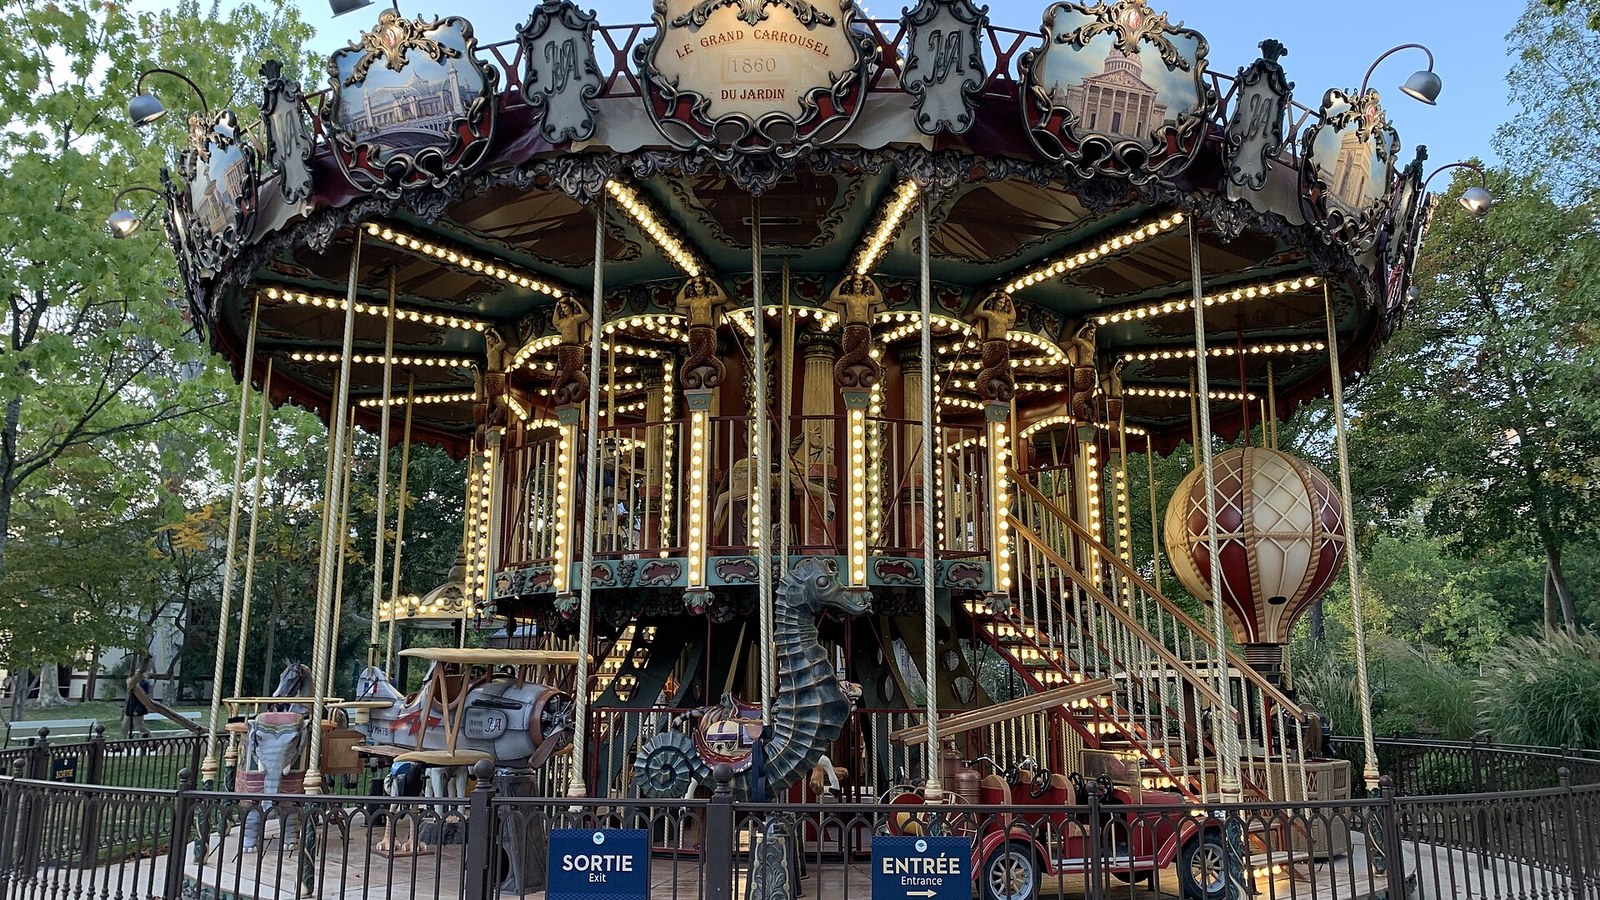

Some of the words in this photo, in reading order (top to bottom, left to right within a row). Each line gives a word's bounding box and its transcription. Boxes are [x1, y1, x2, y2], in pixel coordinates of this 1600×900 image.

[676, 43, 693, 59] LE
[700, 30, 744, 47] GRAND
[753, 29, 829, 57] CARROUSEL
[731, 57, 776, 73] 1860
[721, 89, 737, 100] DU
[740, 88, 785, 99] JARDIN
[562, 854, 633, 872] SORTIE
[882, 852, 961, 874] ENTRÉE
[589, 873, 607, 883] Exit
[901, 876, 943, 886] Entrance
